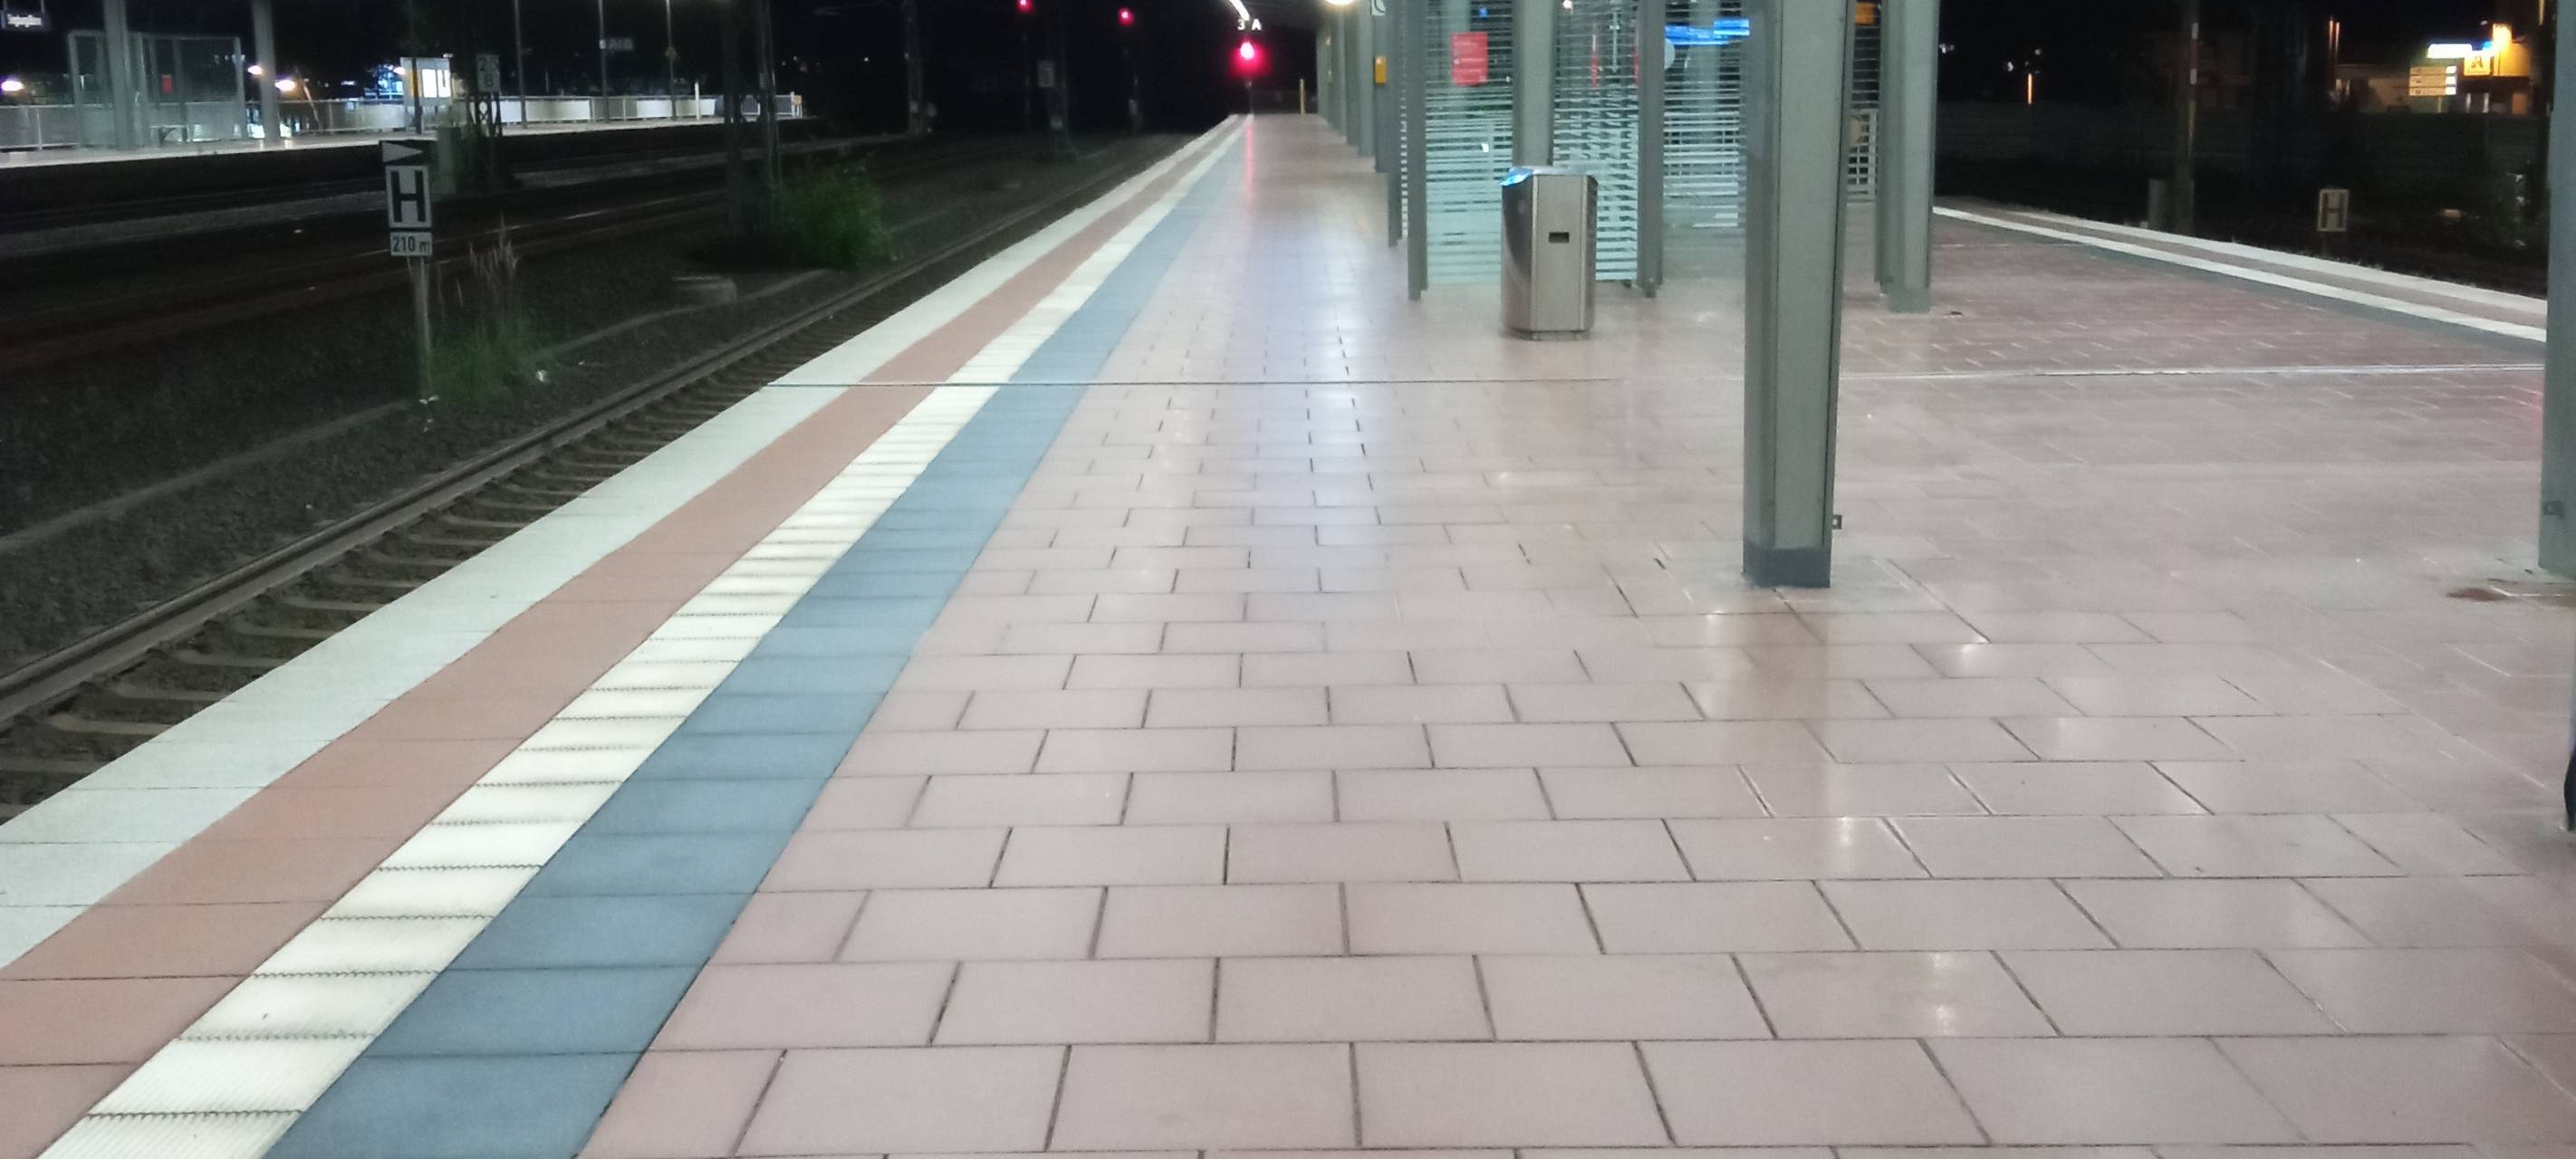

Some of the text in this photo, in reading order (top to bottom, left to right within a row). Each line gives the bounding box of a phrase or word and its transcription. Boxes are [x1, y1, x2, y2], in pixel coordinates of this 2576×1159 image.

[1237, 18, 1262, 31] 3 A
[390, 169, 427, 223] H
[2321, 193, 2345, 228] H
[392, 235, 431, 253] 210 m
